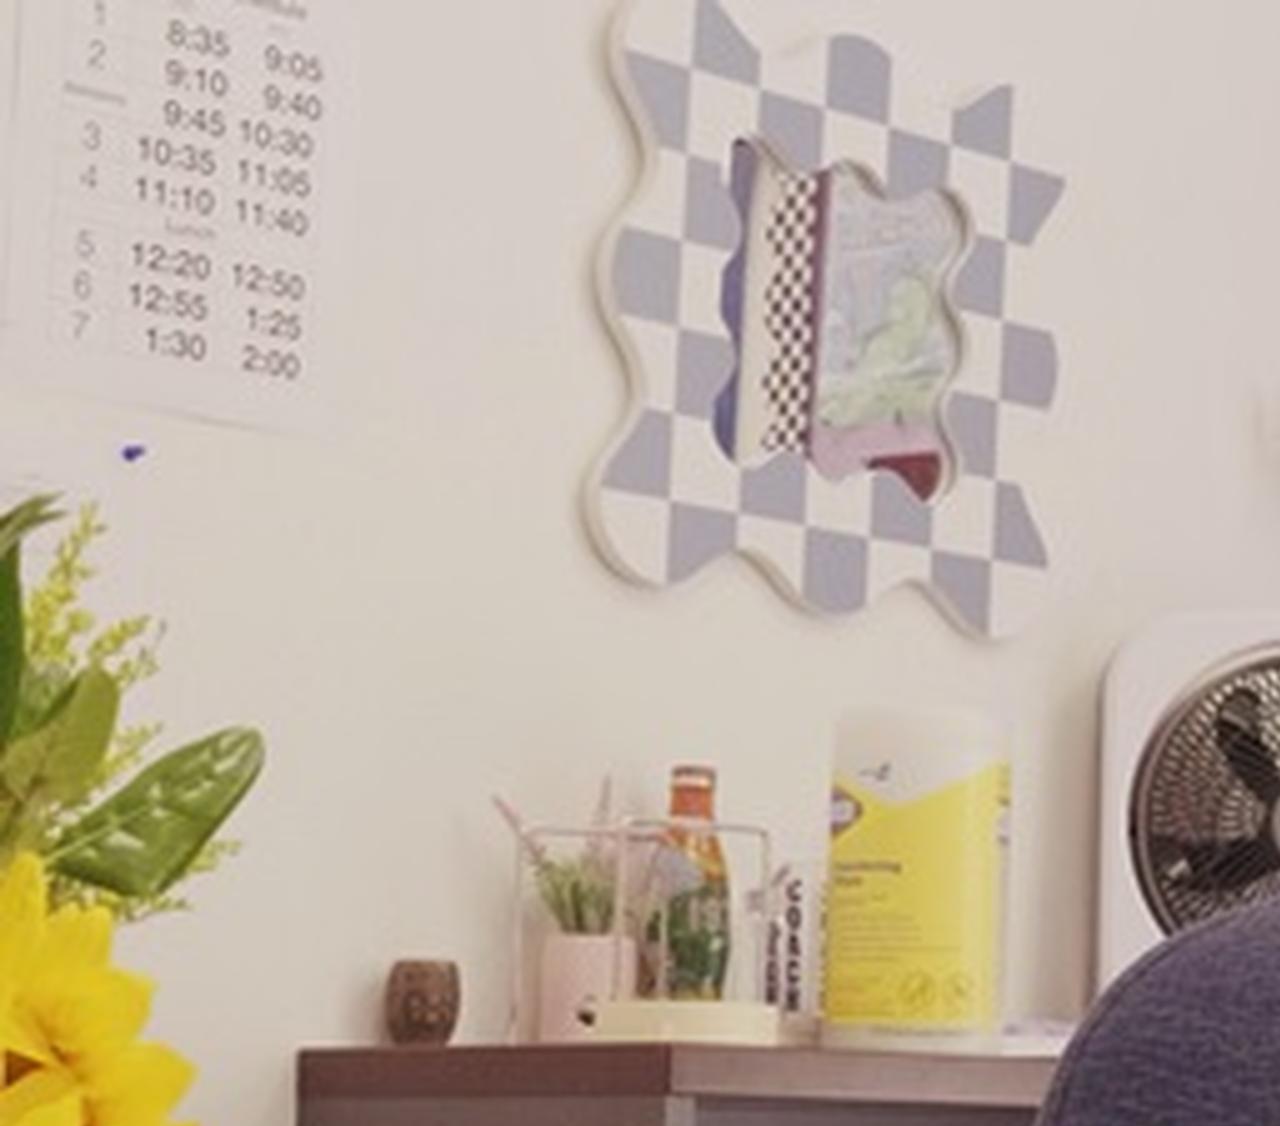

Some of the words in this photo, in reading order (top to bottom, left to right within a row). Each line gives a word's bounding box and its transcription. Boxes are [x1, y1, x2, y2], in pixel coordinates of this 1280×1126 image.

[88, 39, 106, 71] 2
[165, 60, 228, 97] 9:10
[263, 84, 323, 121] 9:40
[167, 19, 230, 57] 8:35
[264, 45, 323, 83] 9:05
[82, 120, 102, 151] 3
[138, 136, 216, 176] 10:35
[238, 158, 311, 199] 11:05
[164, 99, 226, 138] 9:45
[239, 119, 313, 158] 10:30
[137, 177, 215, 216] 11:10
[237, 199, 309, 237] 11:40
[75, 229, 95, 259] 5
[132, 242, 212, 281] 12:20
[233, 263, 305, 301] 12:50
[73, 270, 93, 301] 6
[130, 284, 208, 322] 12:55
[247, 306, 302, 342] 1:25
[71, 310, 91, 340] 7
[146, 327, 207, 362] 1:30
[242, 344, 301, 381] 2:00
